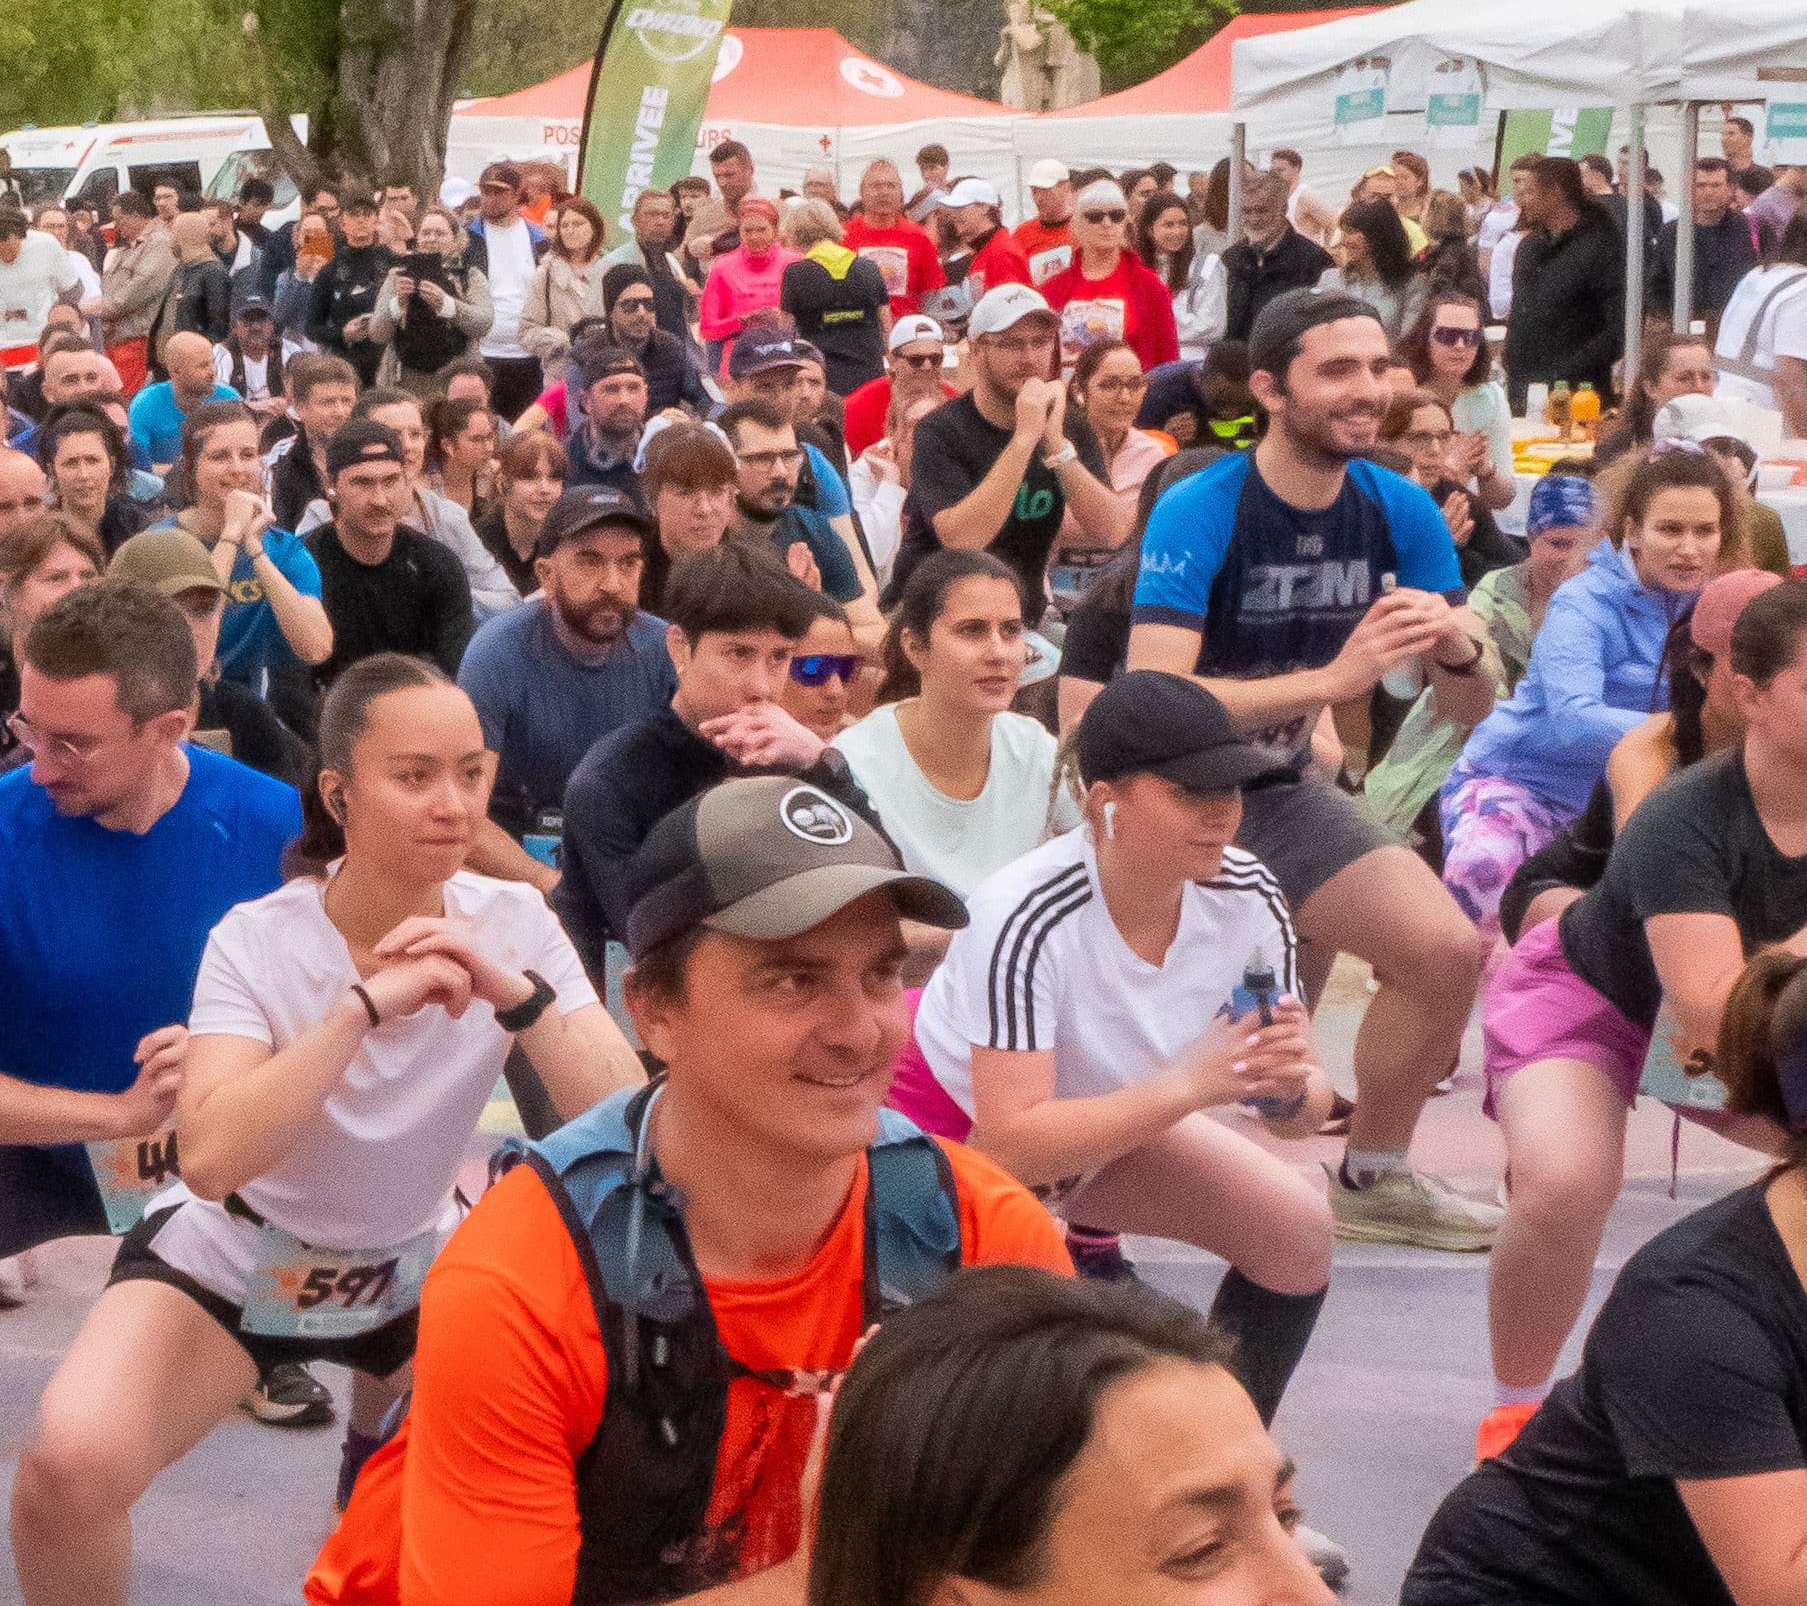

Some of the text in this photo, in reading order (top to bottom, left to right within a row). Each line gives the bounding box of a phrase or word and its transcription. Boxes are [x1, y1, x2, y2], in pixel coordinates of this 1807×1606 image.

[625, 8, 723, 40] CHRONO
[543, 125, 581, 145] POS
[297, 1257, 400, 1309] 597
